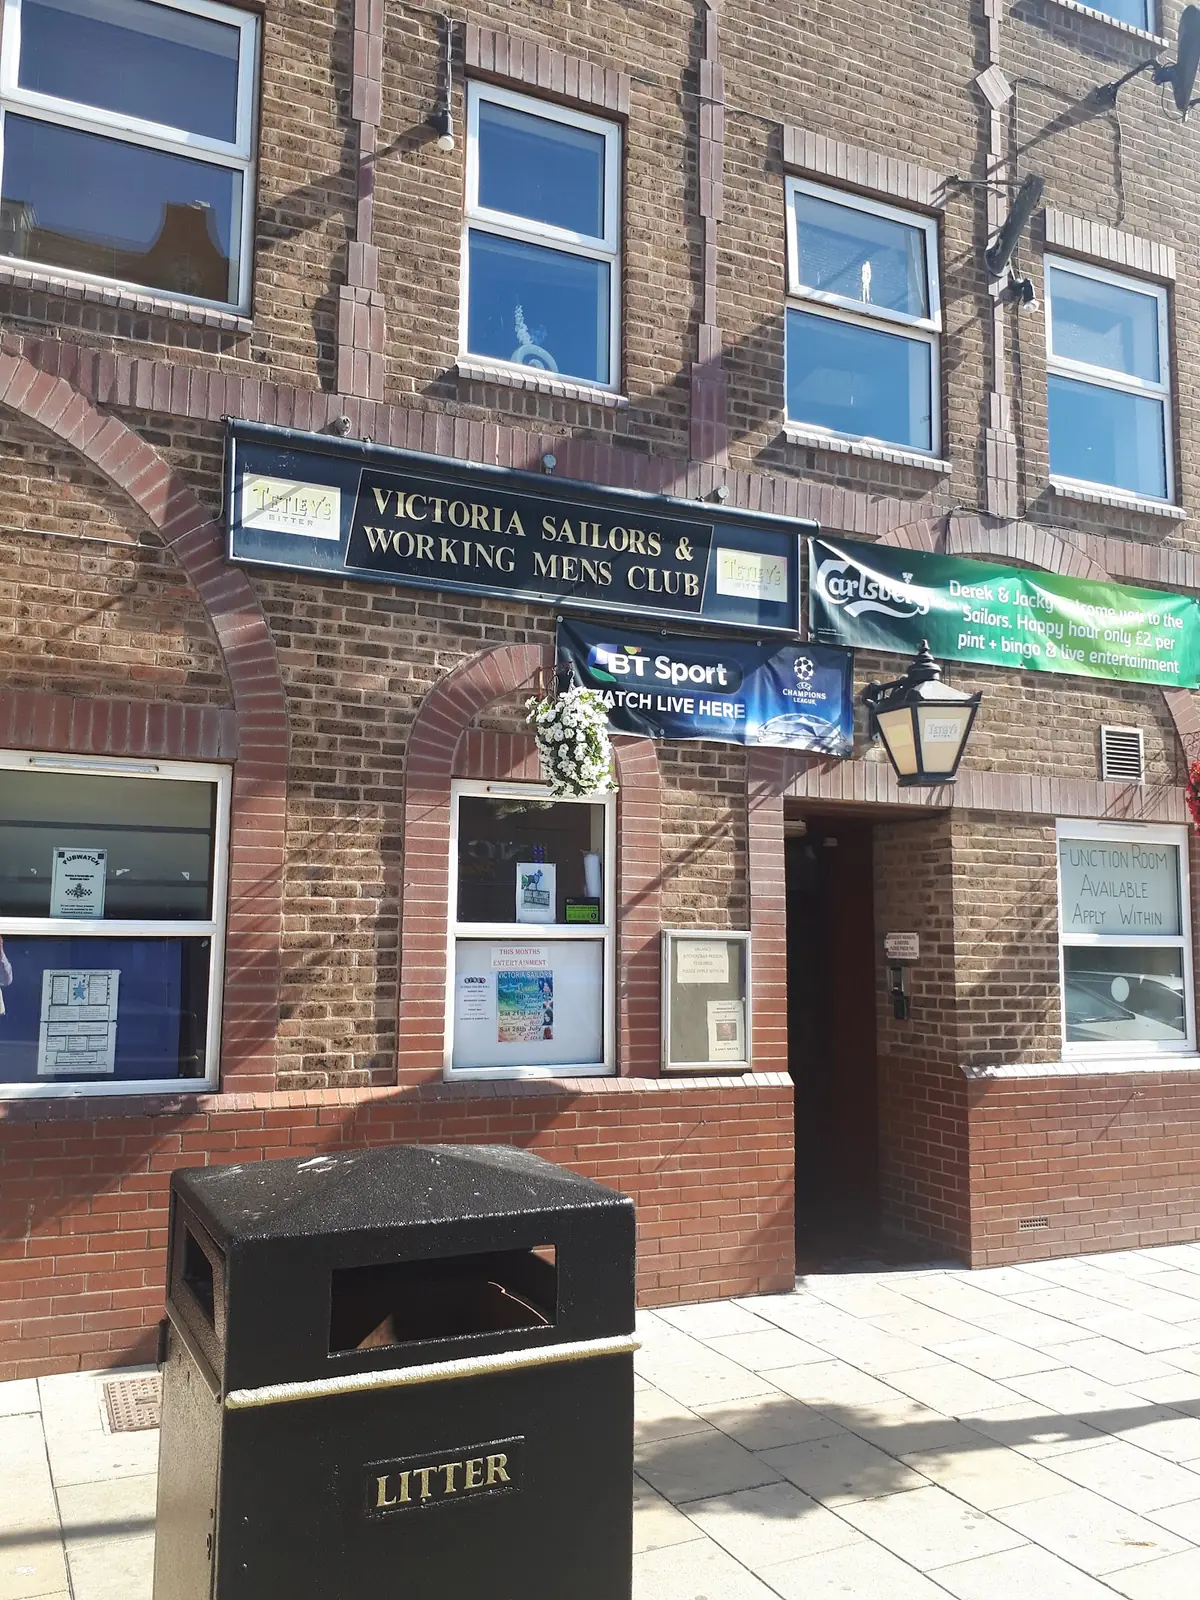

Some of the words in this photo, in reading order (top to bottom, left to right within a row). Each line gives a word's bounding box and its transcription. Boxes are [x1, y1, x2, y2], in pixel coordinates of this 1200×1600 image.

[268, 514, 314, 526] BITTER
[371, 487, 527, 537] VICTORIA
[541, 515, 662, 557] SAILORS
[675, 536, 694, 561] &
[362, 525, 516, 573] WORKING
[532, 551, 612, 586] MENS
[627, 565, 700, 597] CLUB
[949, 580, 994, 601] Derek
[997, 587, 1010, 603] &
[1012, 589, 1054, 613] Jacky
[1147, 612, 1160, 626] to
[1163, 613, 1183, 629] the
[962, 605, 1012, 629] Sailors.
[1017, 613, 1063, 639] Happy
[1068, 620, 1100, 640] hour
[1103, 628, 1131, 647] only
[1135, 630, 1152, 647] £2
[1155, 636, 1175, 651] per
[958, 631, 985, 650] pint
[989, 639, 997, 649] +
[1001, 635, 1040, 658] bingo
[1045, 641, 1056, 658] &
[1060, 643, 1084, 661] live
[1089, 651, 1180, 674] entertainment
[607, 653, 650, 677] BT
[654, 655, 728, 686] Sport
[782, 688, 827, 700] CHAMPIONS
[793, 697, 818, 706] LEAGUE
[656, 695, 695, 715] LIVE
[699, 700, 746, 719] HERE
[62, 854, 100, 866] PUBWATCH
[1131, 844, 1168, 870] ROOM
[1080, 873, 1149, 899] AVAILABLE
[1072, 902, 1107, 925] APPLY
[1118, 903, 1163, 925] WITHIN
[493, 959, 547, 967] ENTERTAINMENT
[498, 971, 526, 979] VICTORIA
[527, 970, 552, 978] SAILORS
[528, 1025, 541, 1033] July
[376, 1451, 511, 1507] LITTER
